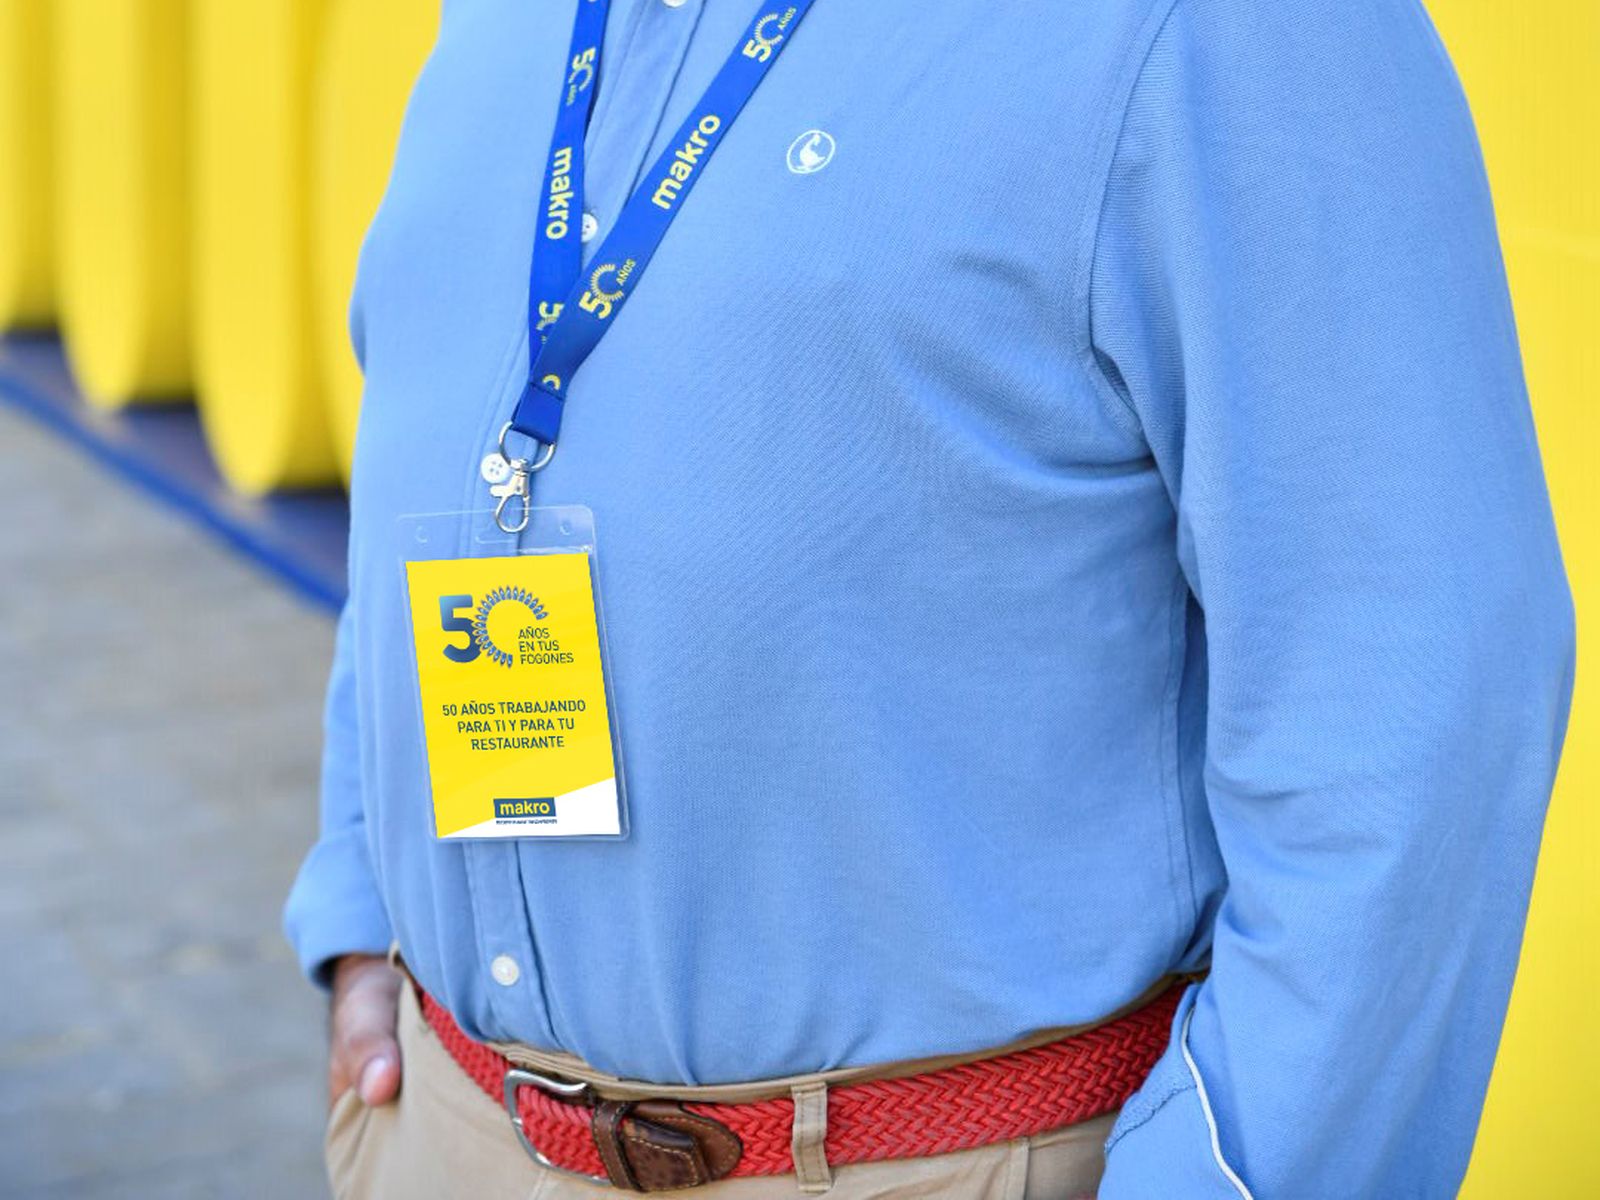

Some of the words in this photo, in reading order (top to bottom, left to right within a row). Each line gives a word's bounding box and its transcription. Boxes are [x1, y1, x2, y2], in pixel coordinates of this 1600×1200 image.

[777, 7, 796, 31] AÑOS
[652, 114, 720, 210] makro
[545, 147, 574, 240] makro
[616, 259, 636, 286] AÑOS
[518, 626, 549, 639] AÑOS
[519, 641, 535, 652] EN
[537, 640, 559, 652] TUS
[520, 653, 574, 665] FOGONES
[442, 704, 457, 716] 50
[460, 700, 495, 716] AÑOS
[498, 700, 586, 715] TRABAJANDO
[457, 721, 491, 734] PARA
[494, 720, 506, 732] TI
[509, 720, 517, 731] Y
[520, 719, 555, 731] PARA
[557, 718, 575, 730] TU
[471, 735, 565, 750] RESTAURANTE
[500, 800, 550, 815] makro
